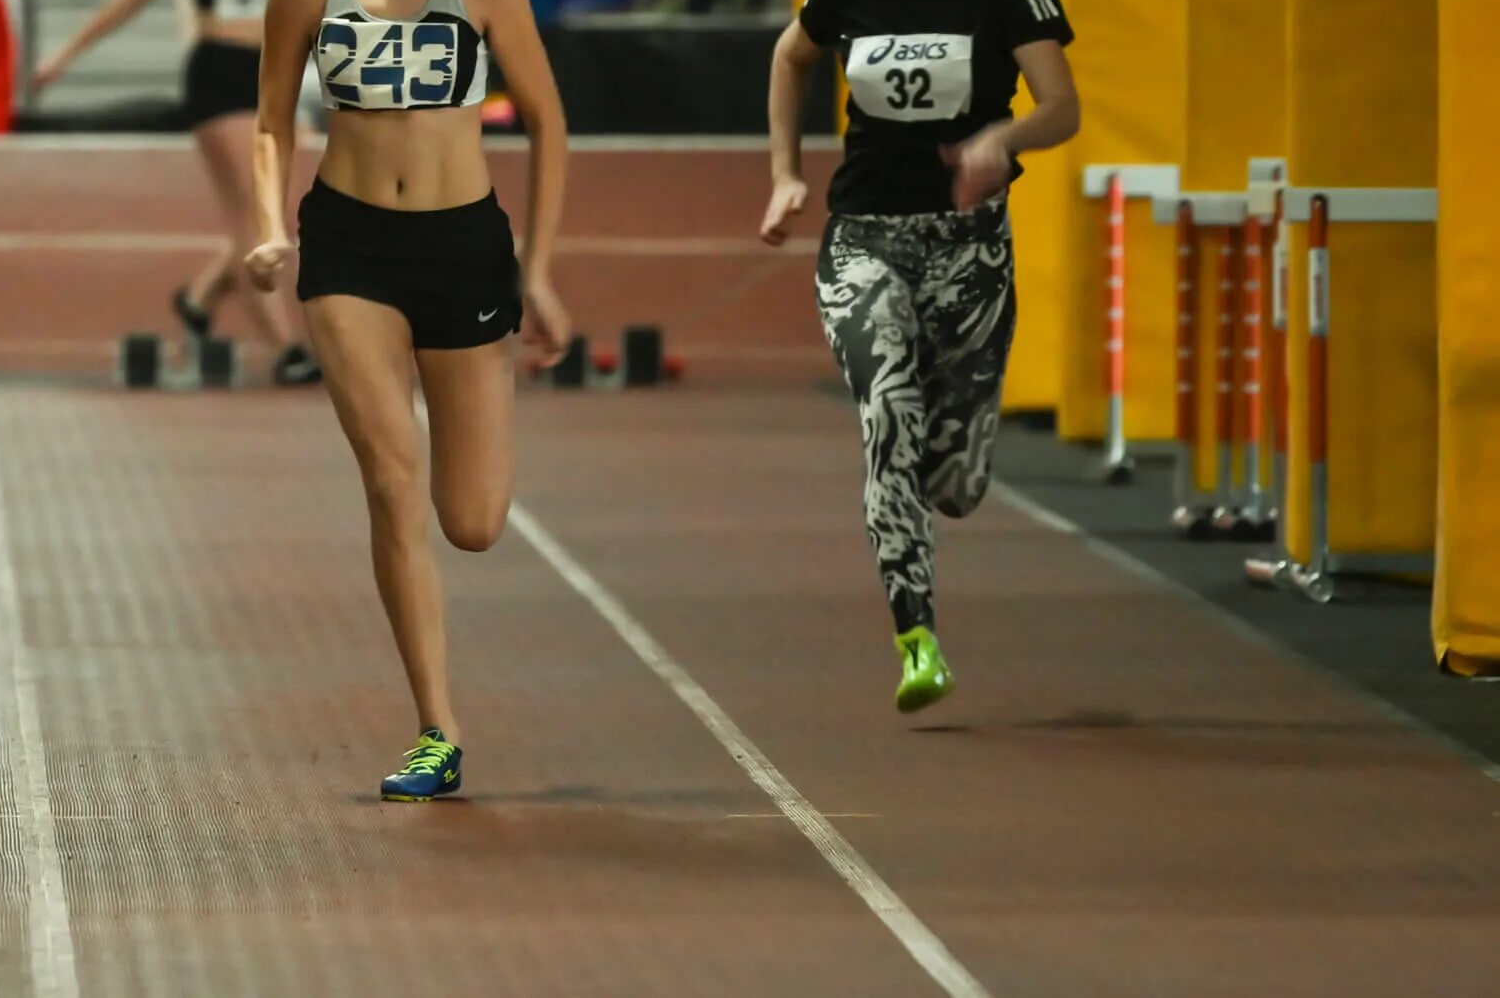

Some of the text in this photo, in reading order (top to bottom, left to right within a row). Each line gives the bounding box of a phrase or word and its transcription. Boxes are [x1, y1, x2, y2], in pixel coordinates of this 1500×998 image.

[318, 23, 455, 104] 243
[893, 42, 950, 61] asics
[884, 67, 935, 111] 32
